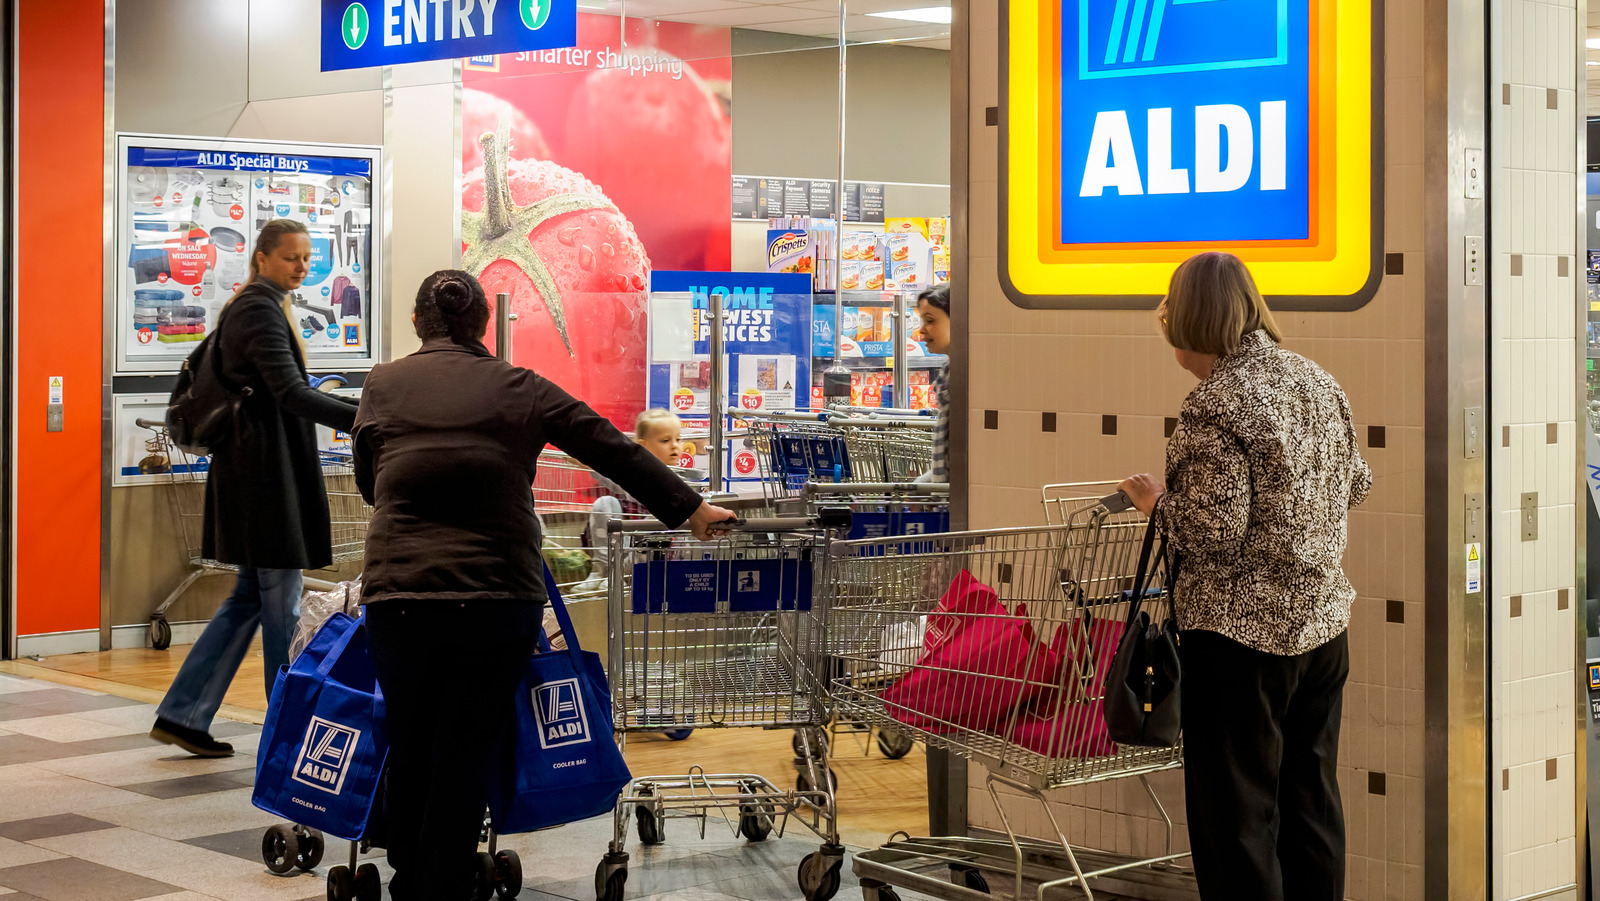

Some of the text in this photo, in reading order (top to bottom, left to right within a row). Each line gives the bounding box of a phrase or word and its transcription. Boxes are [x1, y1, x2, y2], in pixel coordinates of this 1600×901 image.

[384, 0, 498, 47] ENTRY
[596, 46, 684, 80] shopping
[1079, 100, 1287, 198] ALDI
[197, 153, 309, 173] ALDI Special Buys
[811, 181, 831, 189] Security
[772, 238, 807, 257] Crispetts
[700, 309, 774, 325] LWEST
[548, 721, 583, 740] ALDI
[552, 758, 587, 769] COOLER BAG
[300, 762, 338, 785] ALDI
[291, 796, 327, 812] COOLER BAG
